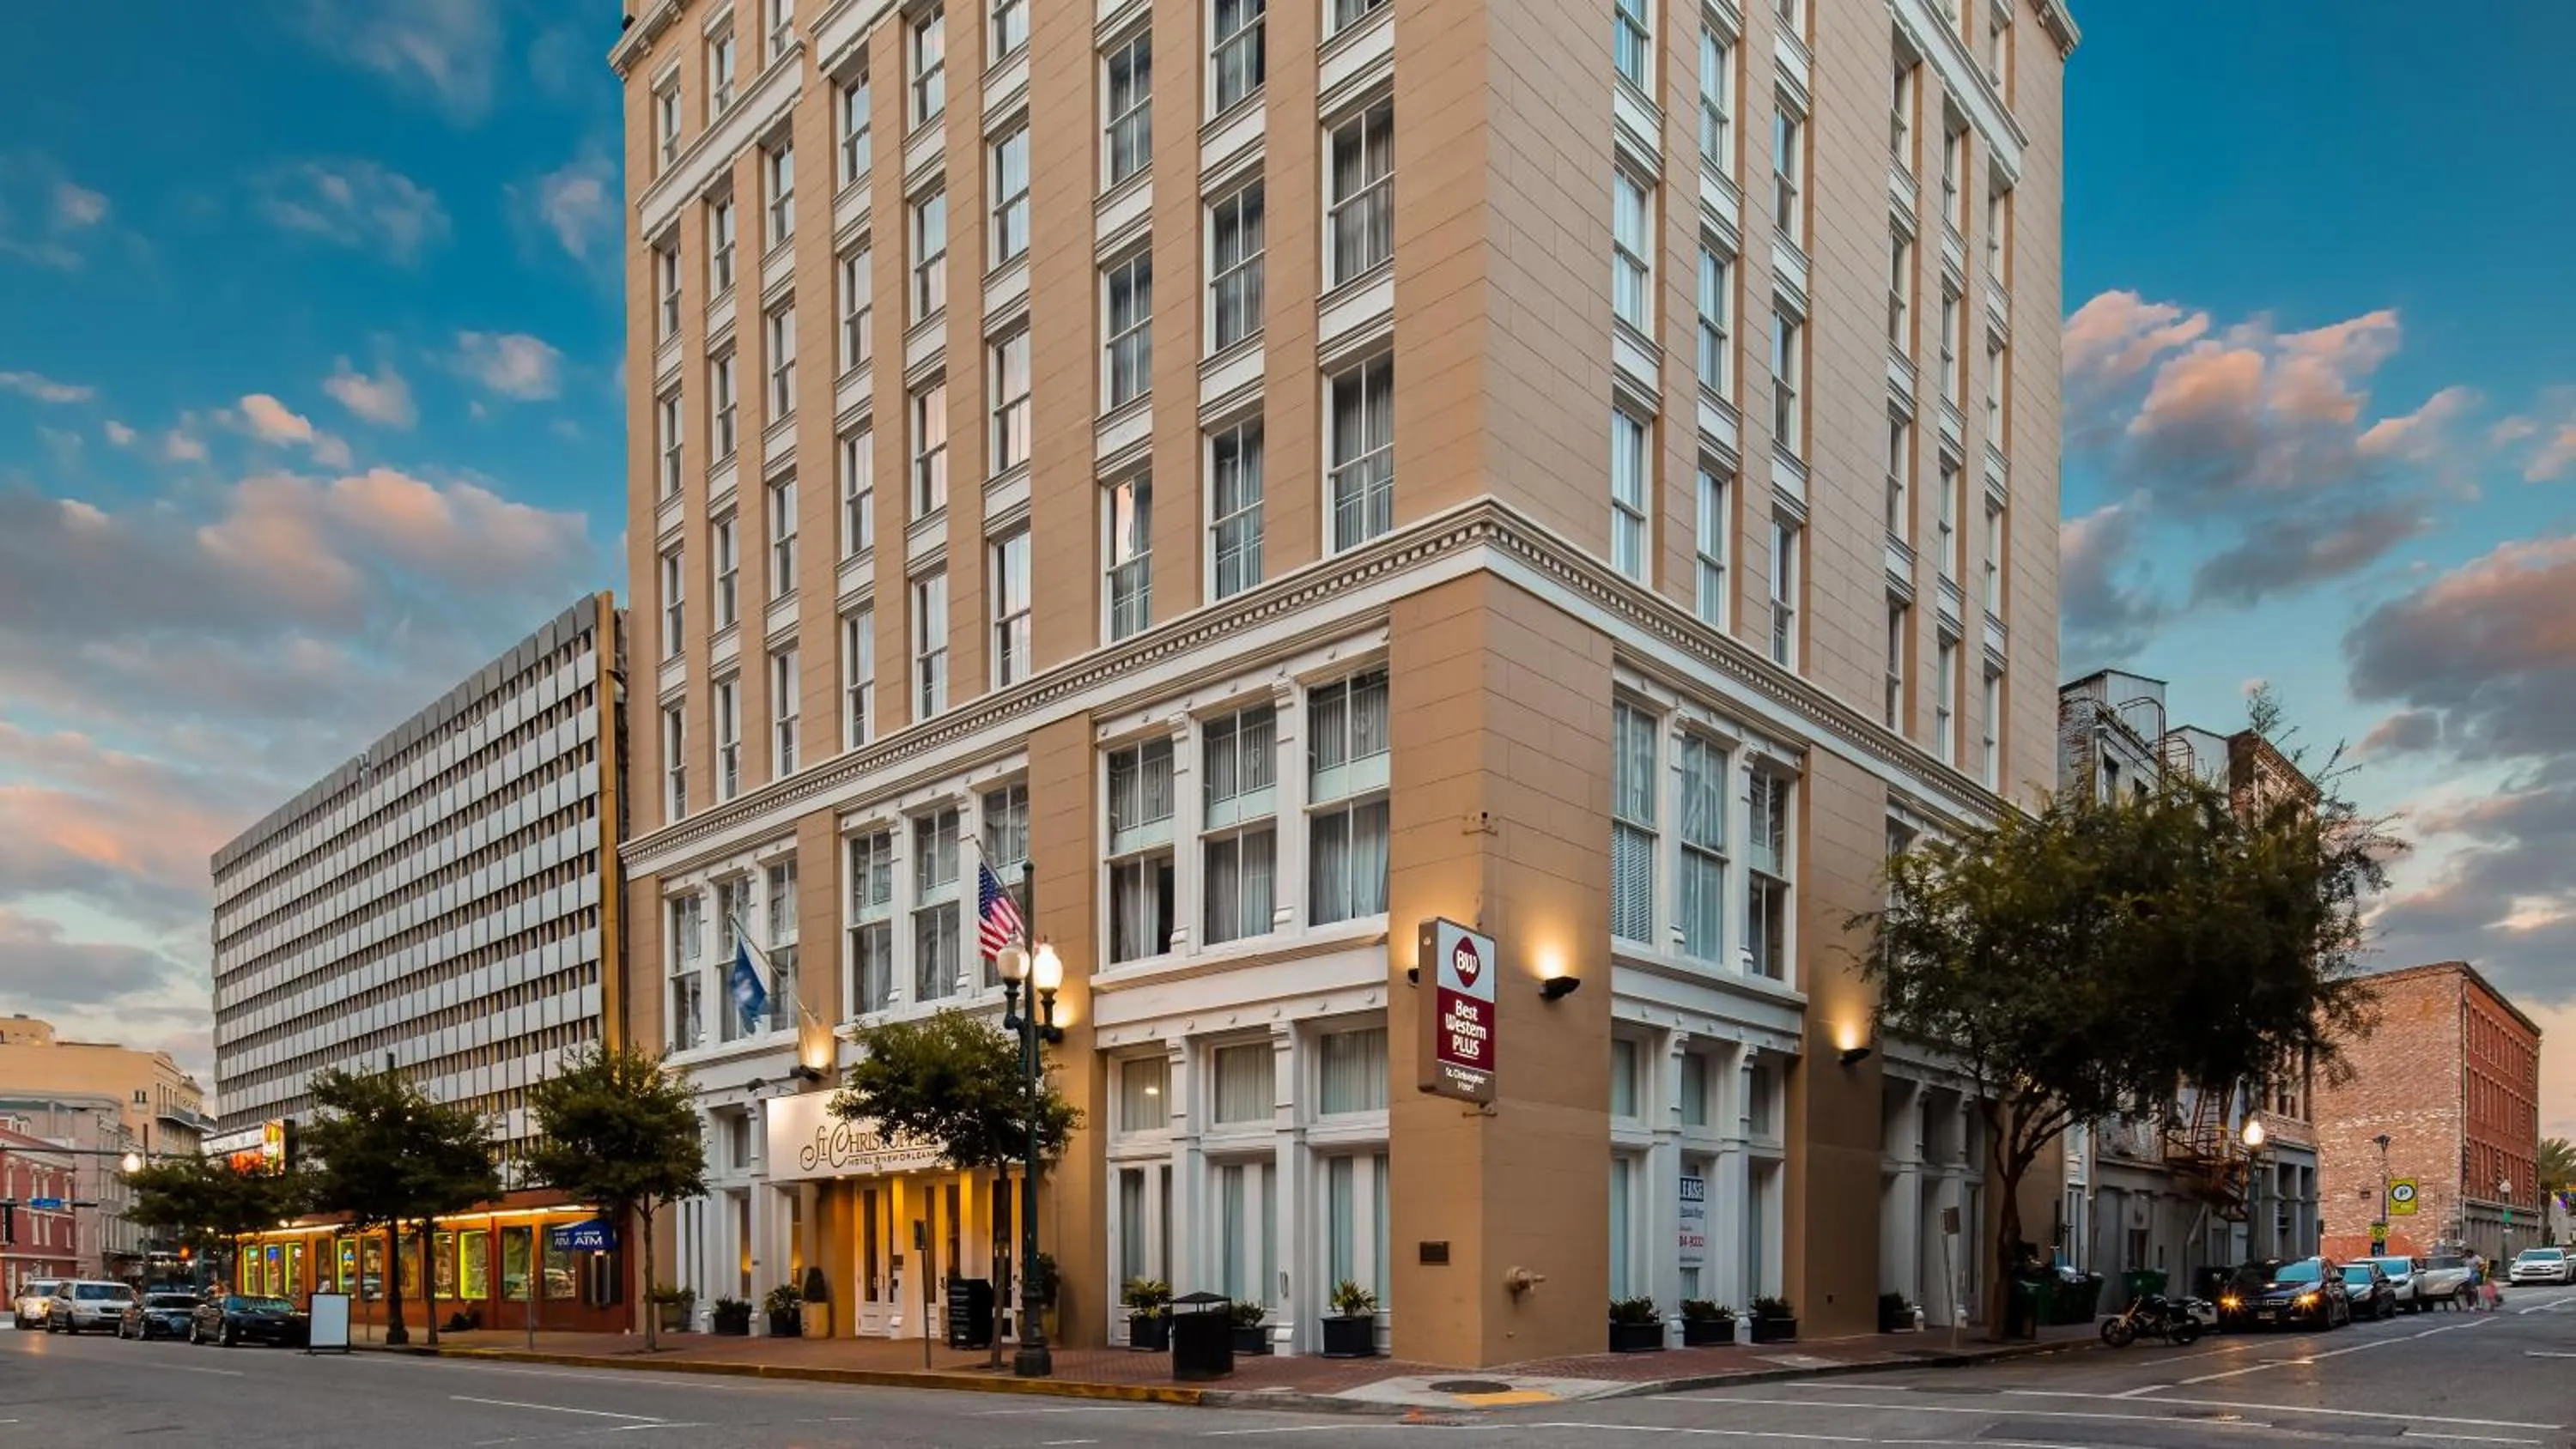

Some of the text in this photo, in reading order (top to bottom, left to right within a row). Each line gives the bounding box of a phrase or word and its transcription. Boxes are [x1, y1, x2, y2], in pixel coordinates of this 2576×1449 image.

[1456, 950, 1477, 974] BW
[1455, 999, 1478, 1021] Best
[1445, 1013, 1486, 1040] Western
[1452, 1035, 1479, 1056] PLUS
[1680, 1179, 1704, 1199] EASE
[574, 1235, 603, 1246] ATM
